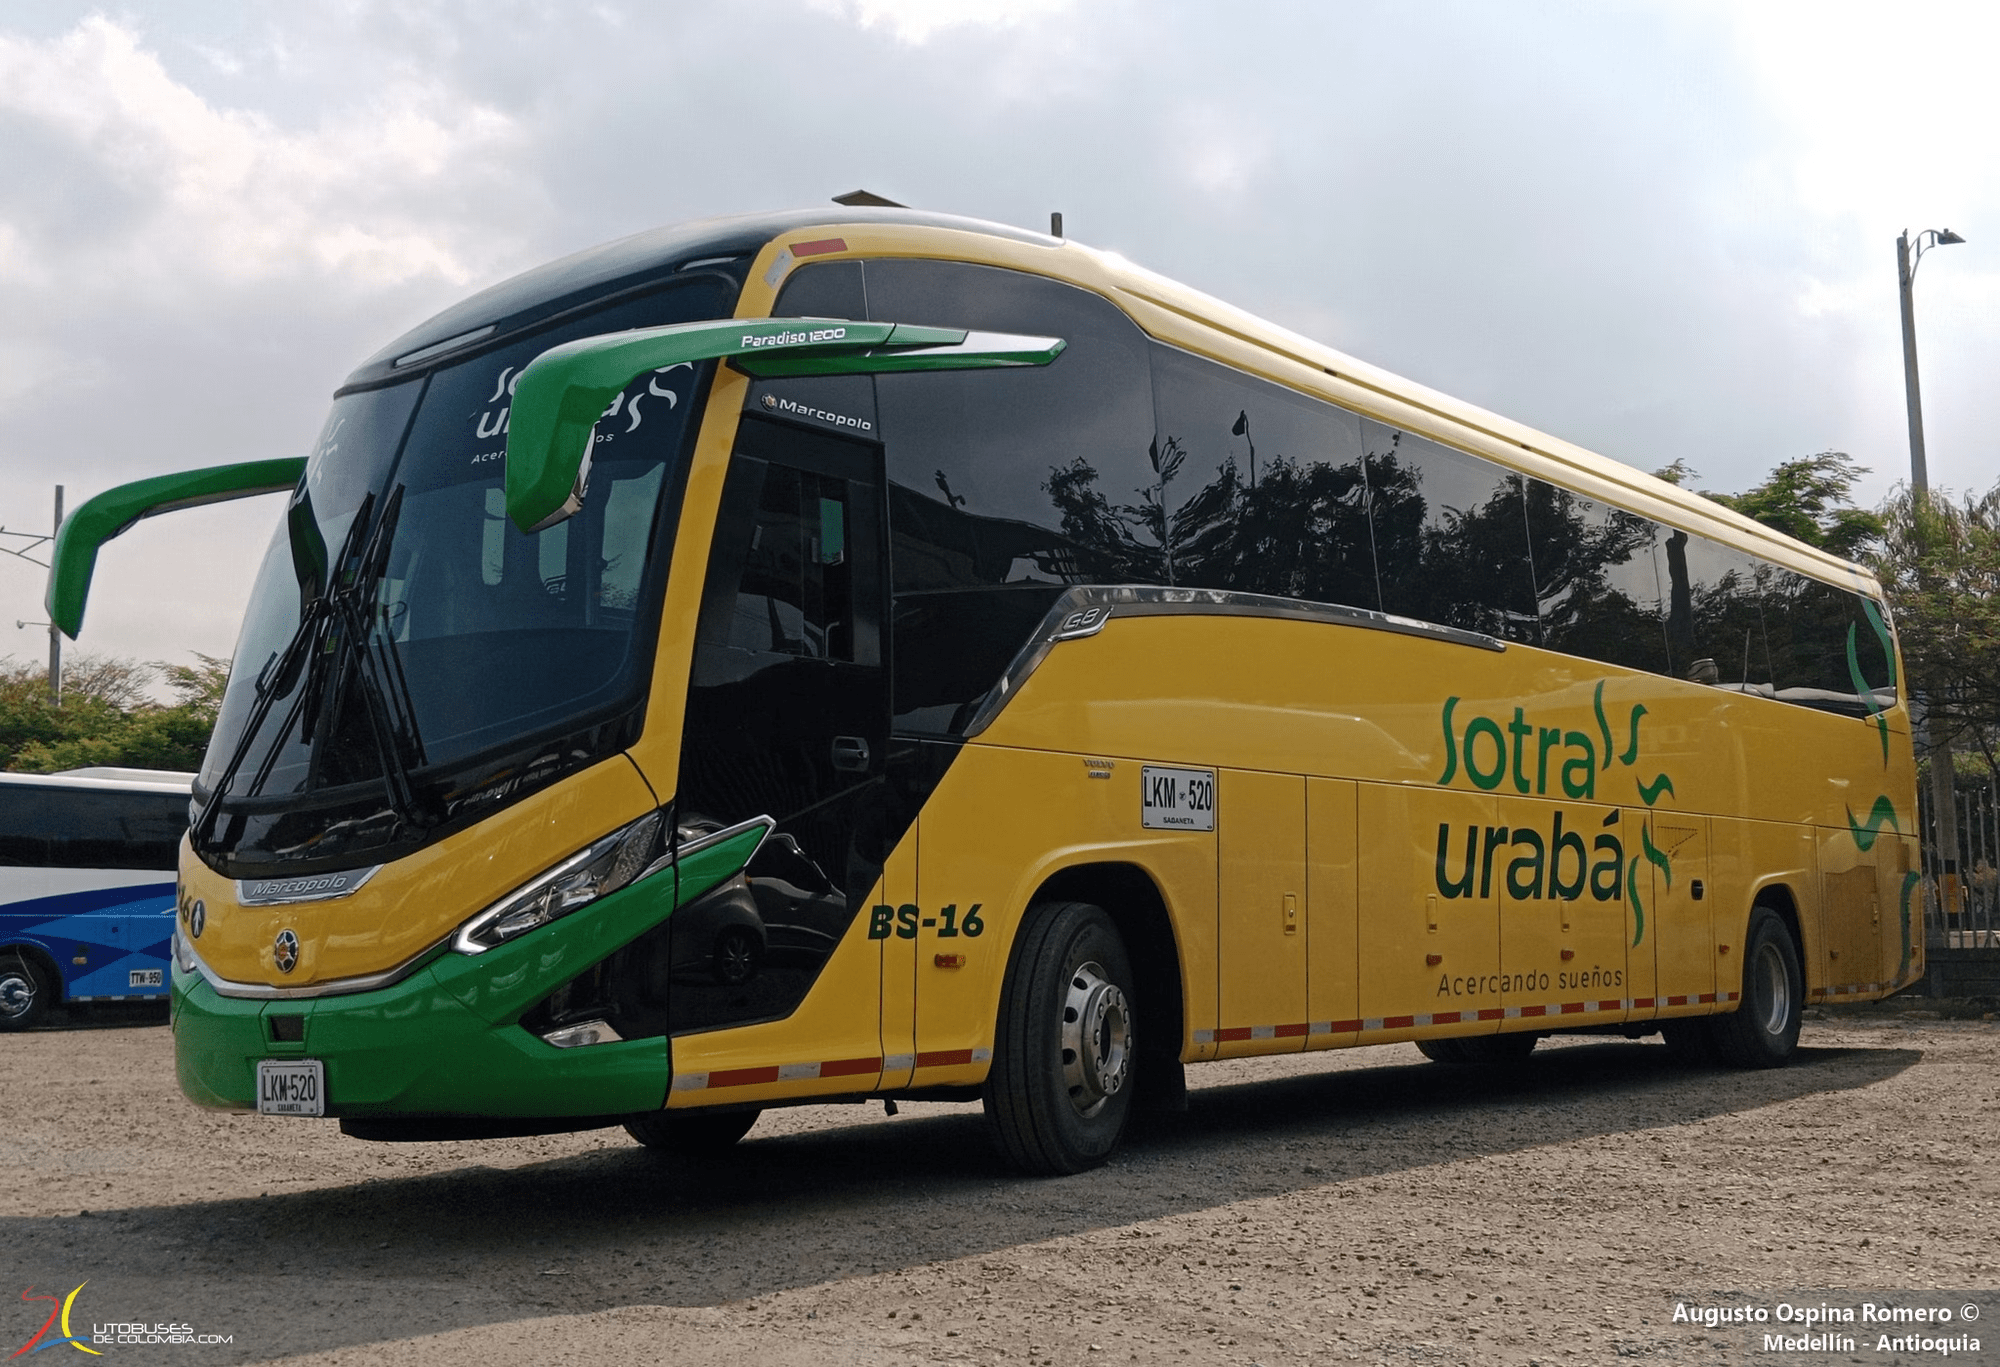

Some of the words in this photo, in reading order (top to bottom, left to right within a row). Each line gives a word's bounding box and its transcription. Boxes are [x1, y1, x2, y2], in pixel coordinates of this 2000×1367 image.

[741, 331, 806, 348] Paradiso
[809, 328, 846, 342] 1200
[779, 398, 872, 431] Marcopolo
[1062, 607, 1101, 630] G8
[251, 874, 348, 896] Marcopolo
[867, 903, 985, 941] BS-16
[1436, 969, 1550, 997] Acercando
[1558, 965, 1623, 989] sueños
